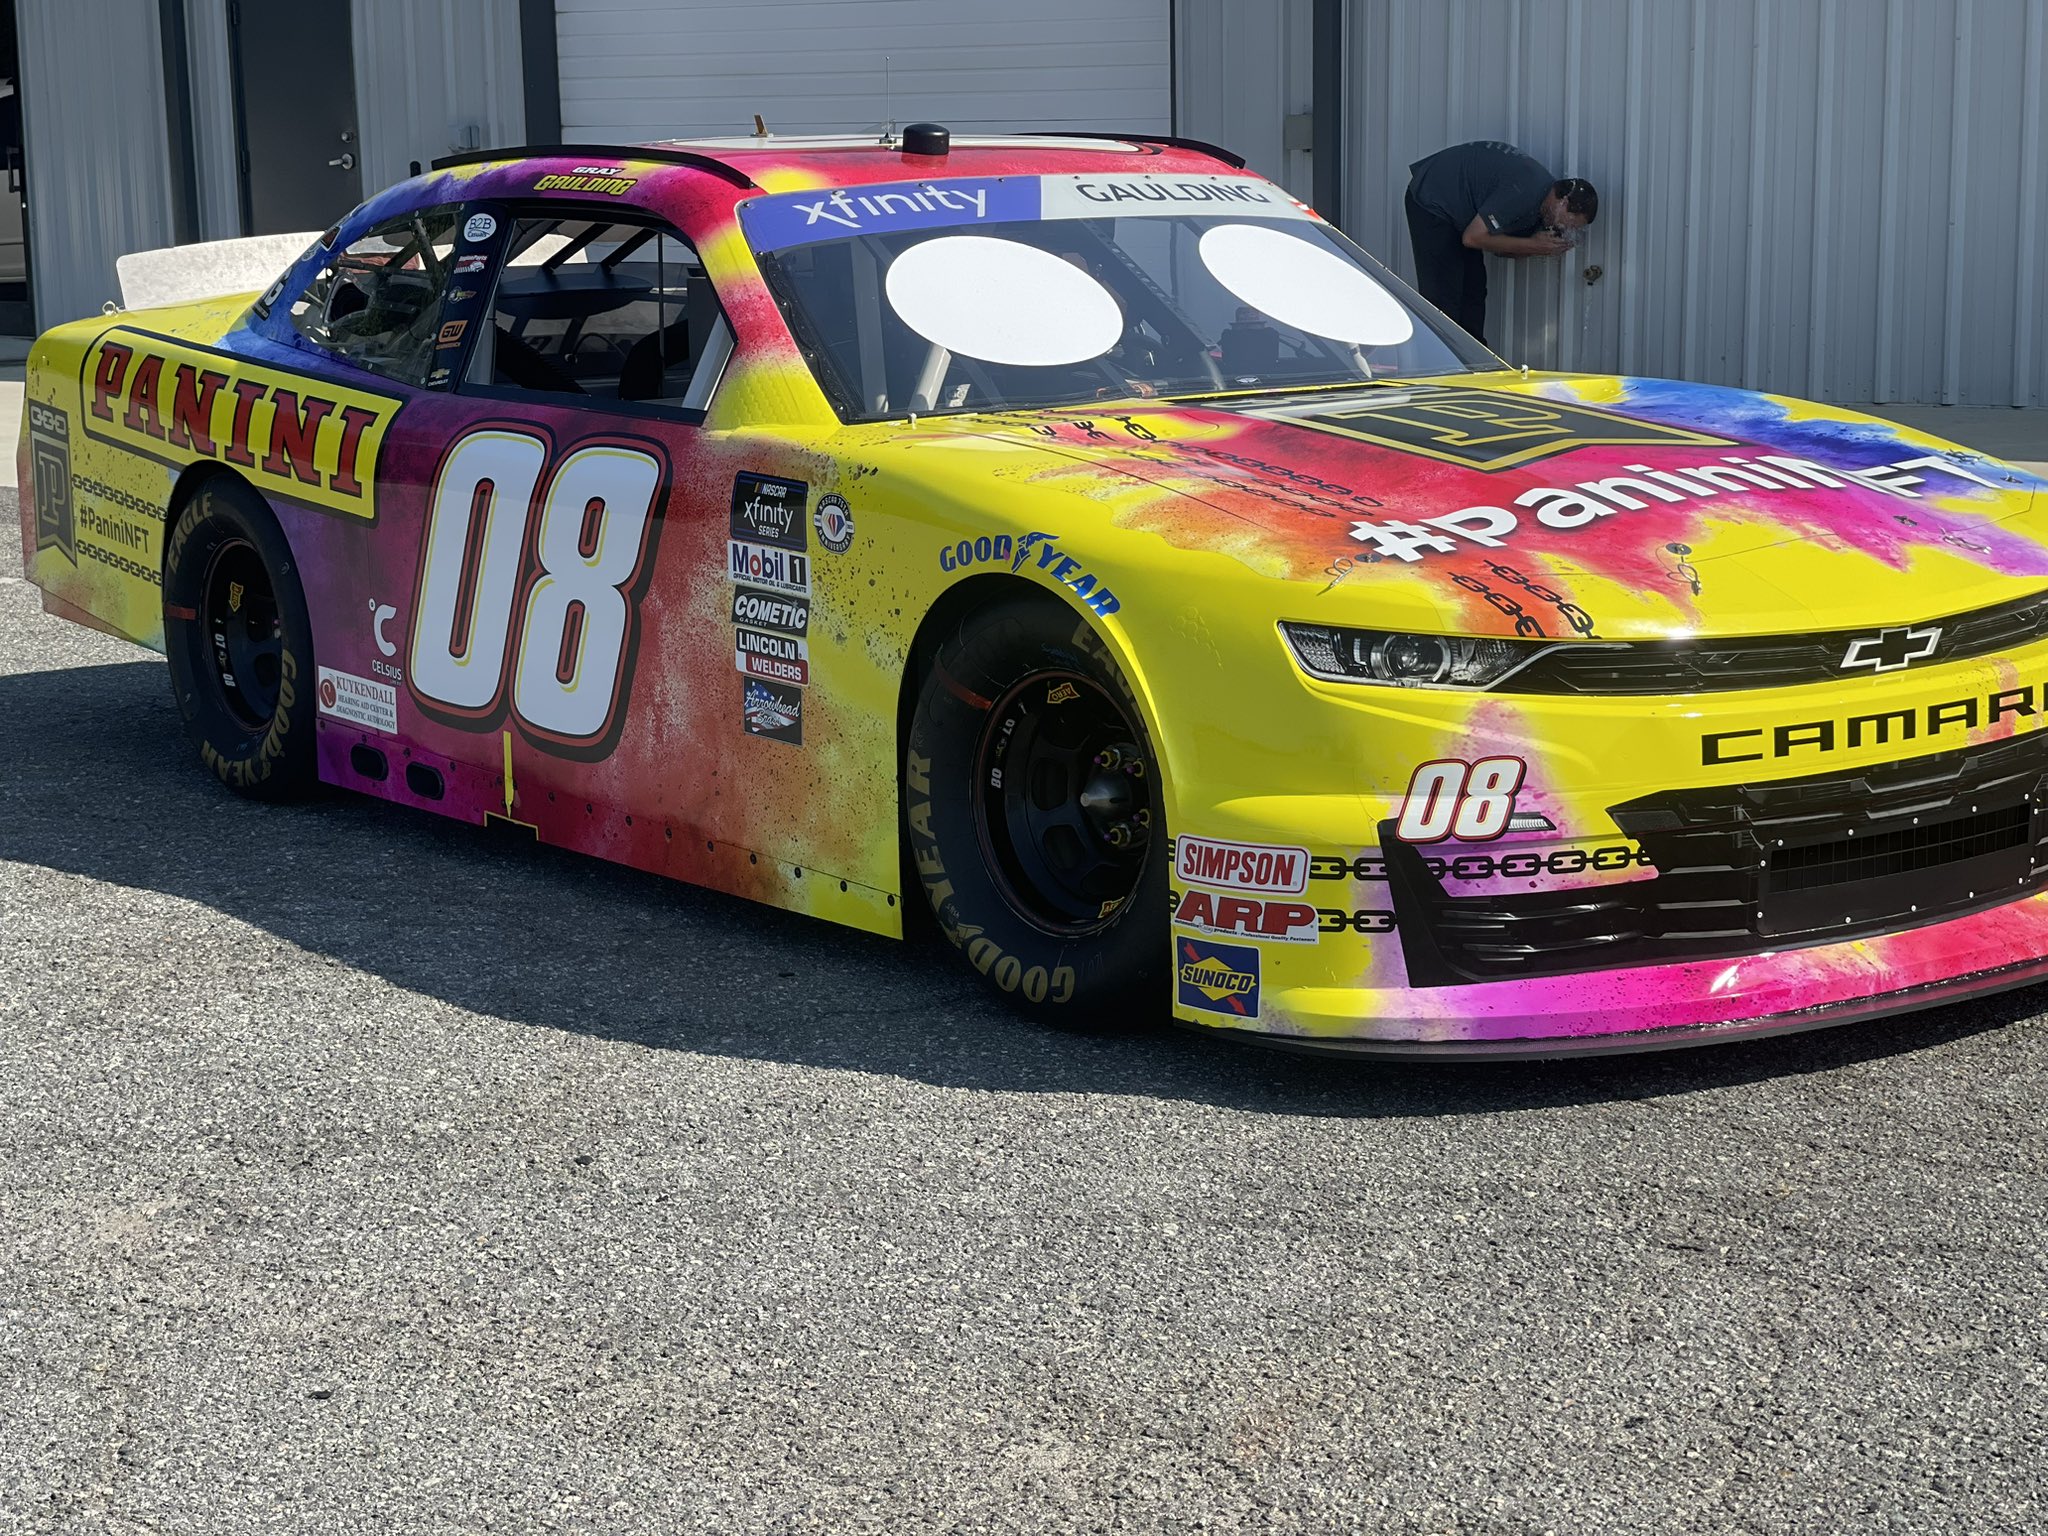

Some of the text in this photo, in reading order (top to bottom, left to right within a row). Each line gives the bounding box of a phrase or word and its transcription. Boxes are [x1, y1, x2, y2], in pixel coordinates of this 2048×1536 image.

[533, 175, 637, 195] GAULDING
[571, 166, 623, 175] GRAY
[793, 184, 987, 228] xfinity
[1076, 182, 1270, 203] GAULDING
[469, 217, 492, 230] B2B
[91, 340, 380, 499] PANINI
[38, 450, 66, 526] P
[761, 483, 788, 498] NASCAR
[80, 504, 150, 554] #PaniniNFT
[167, 491, 215, 574] EAGLE
[744, 496, 793, 534] xfinity
[758, 525, 780, 538] SERIES
[732, 543, 785, 581] Mobil
[940, 535, 1121, 618] GOOD YEAR
[407, 424, 666, 746] 08
[735, 595, 807, 629] COMETIC
[739, 617, 768, 627] GASKET
[739, 631, 796, 660] LINCOLN
[372, 659, 402, 680] CELSIUS
[751, 656, 802, 681] WELDERS
[336, 676, 395, 706] KUYKENDALL
[744, 689, 801, 718] Arrowhead
[1701, 682, 2048, 766] CAMAR
[1397, 756, 1525, 843] 08
[908, 753, 955, 908] YEAR
[1183, 843, 1296, 887] SIMPSON
[1175, 890, 1316, 936] ARP
[1240, 931, 1271, 940] Professional
[966, 936, 1076, 1004] GOOD
[1183, 965, 1253, 992] SUNOCO
